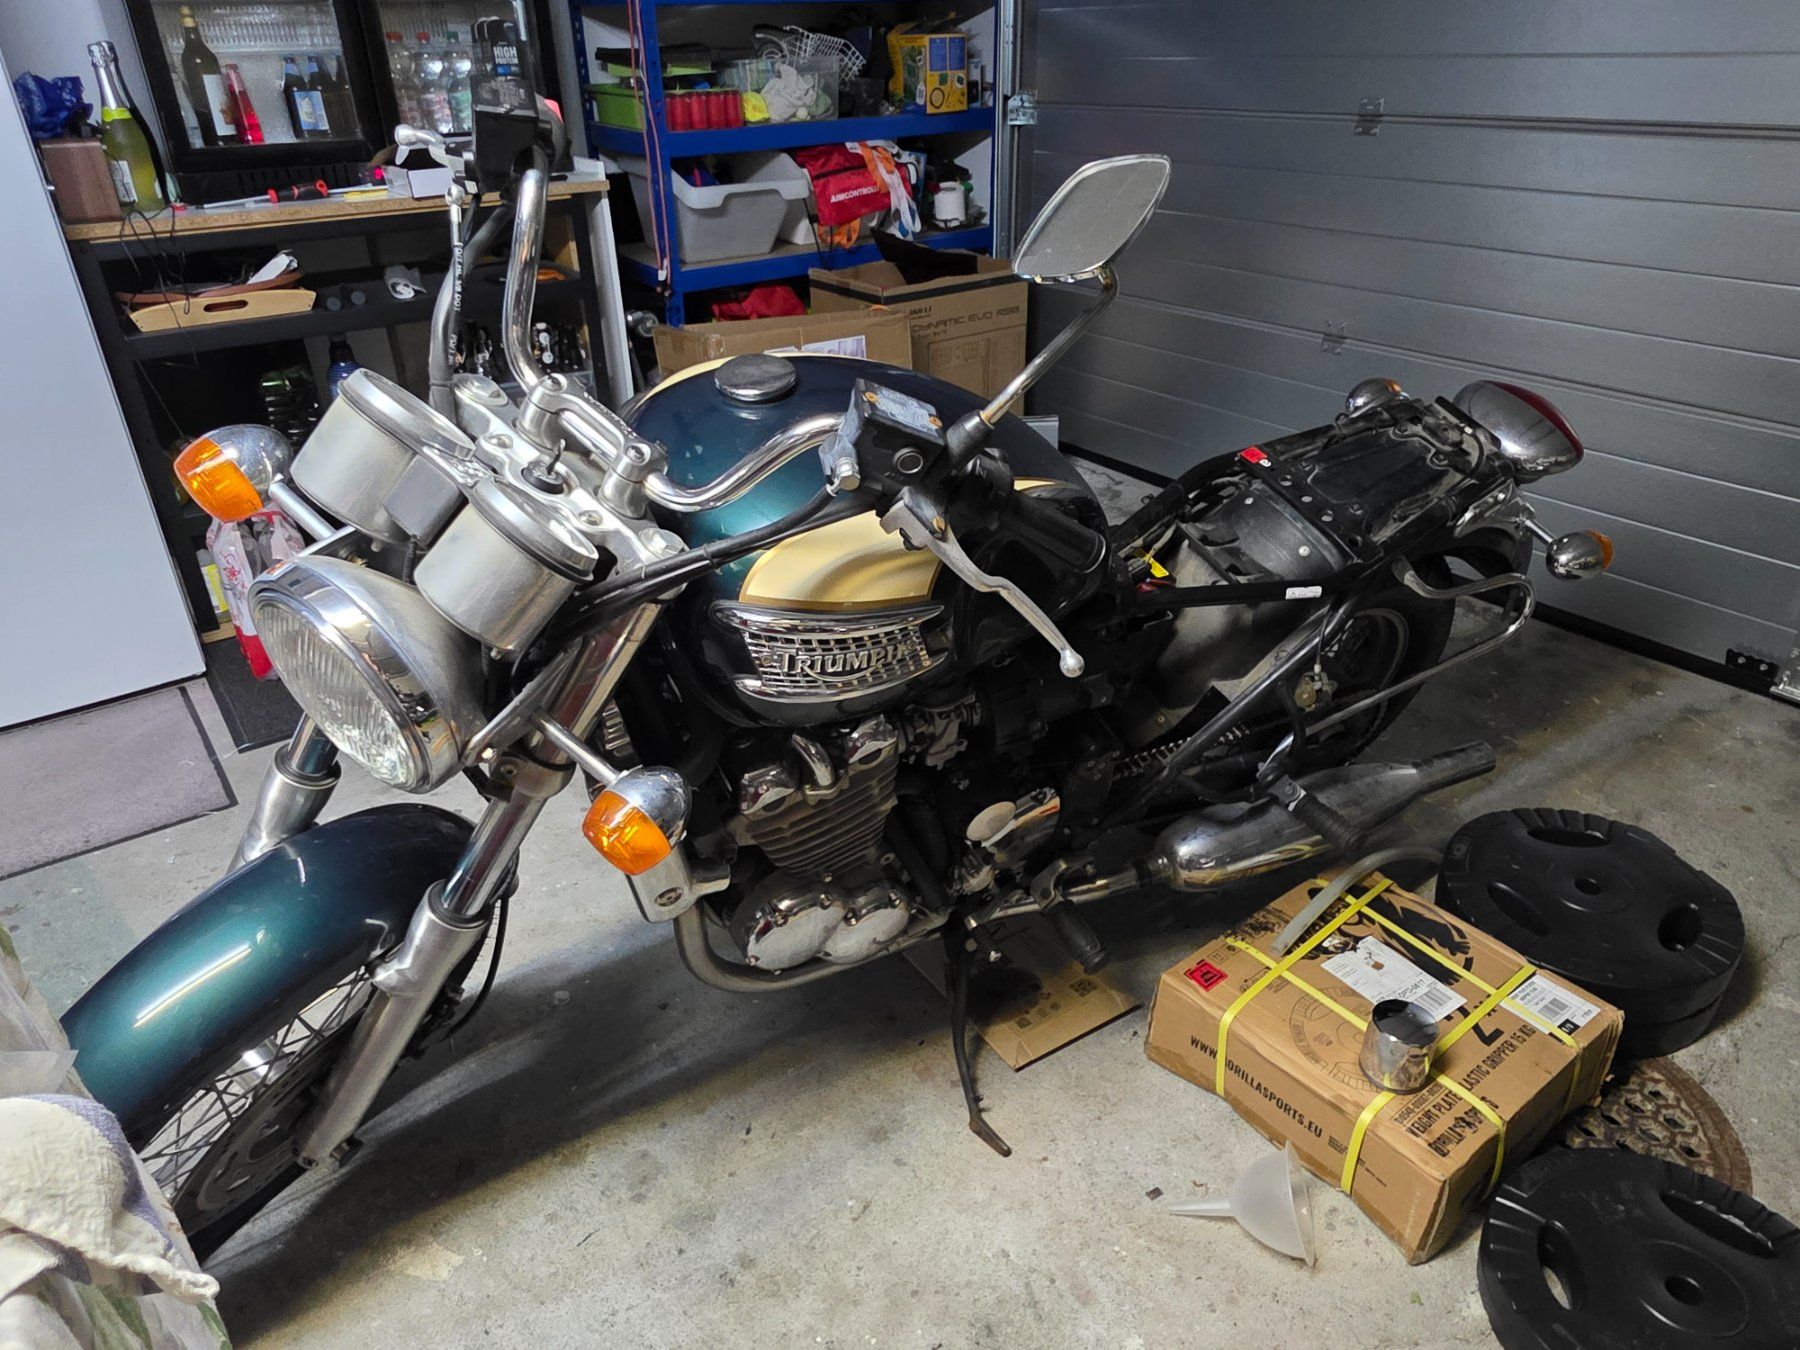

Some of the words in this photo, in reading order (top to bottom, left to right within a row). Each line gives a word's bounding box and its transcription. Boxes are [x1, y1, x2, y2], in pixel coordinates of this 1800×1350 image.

[493, 46, 518, 58] HIGH
[967, 311, 993, 322] EVO
[774, 640, 907, 674] TRIUMPH
[1510, 1031, 1528, 1046] 15
[1517, 1023, 1537, 1039] KG
[1481, 1039, 1520, 1070] GRIPPER
[1190, 1034, 1323, 1138] WWWORILLASPORTS.EU
[1457, 1064, 1491, 1092] LASTIC
